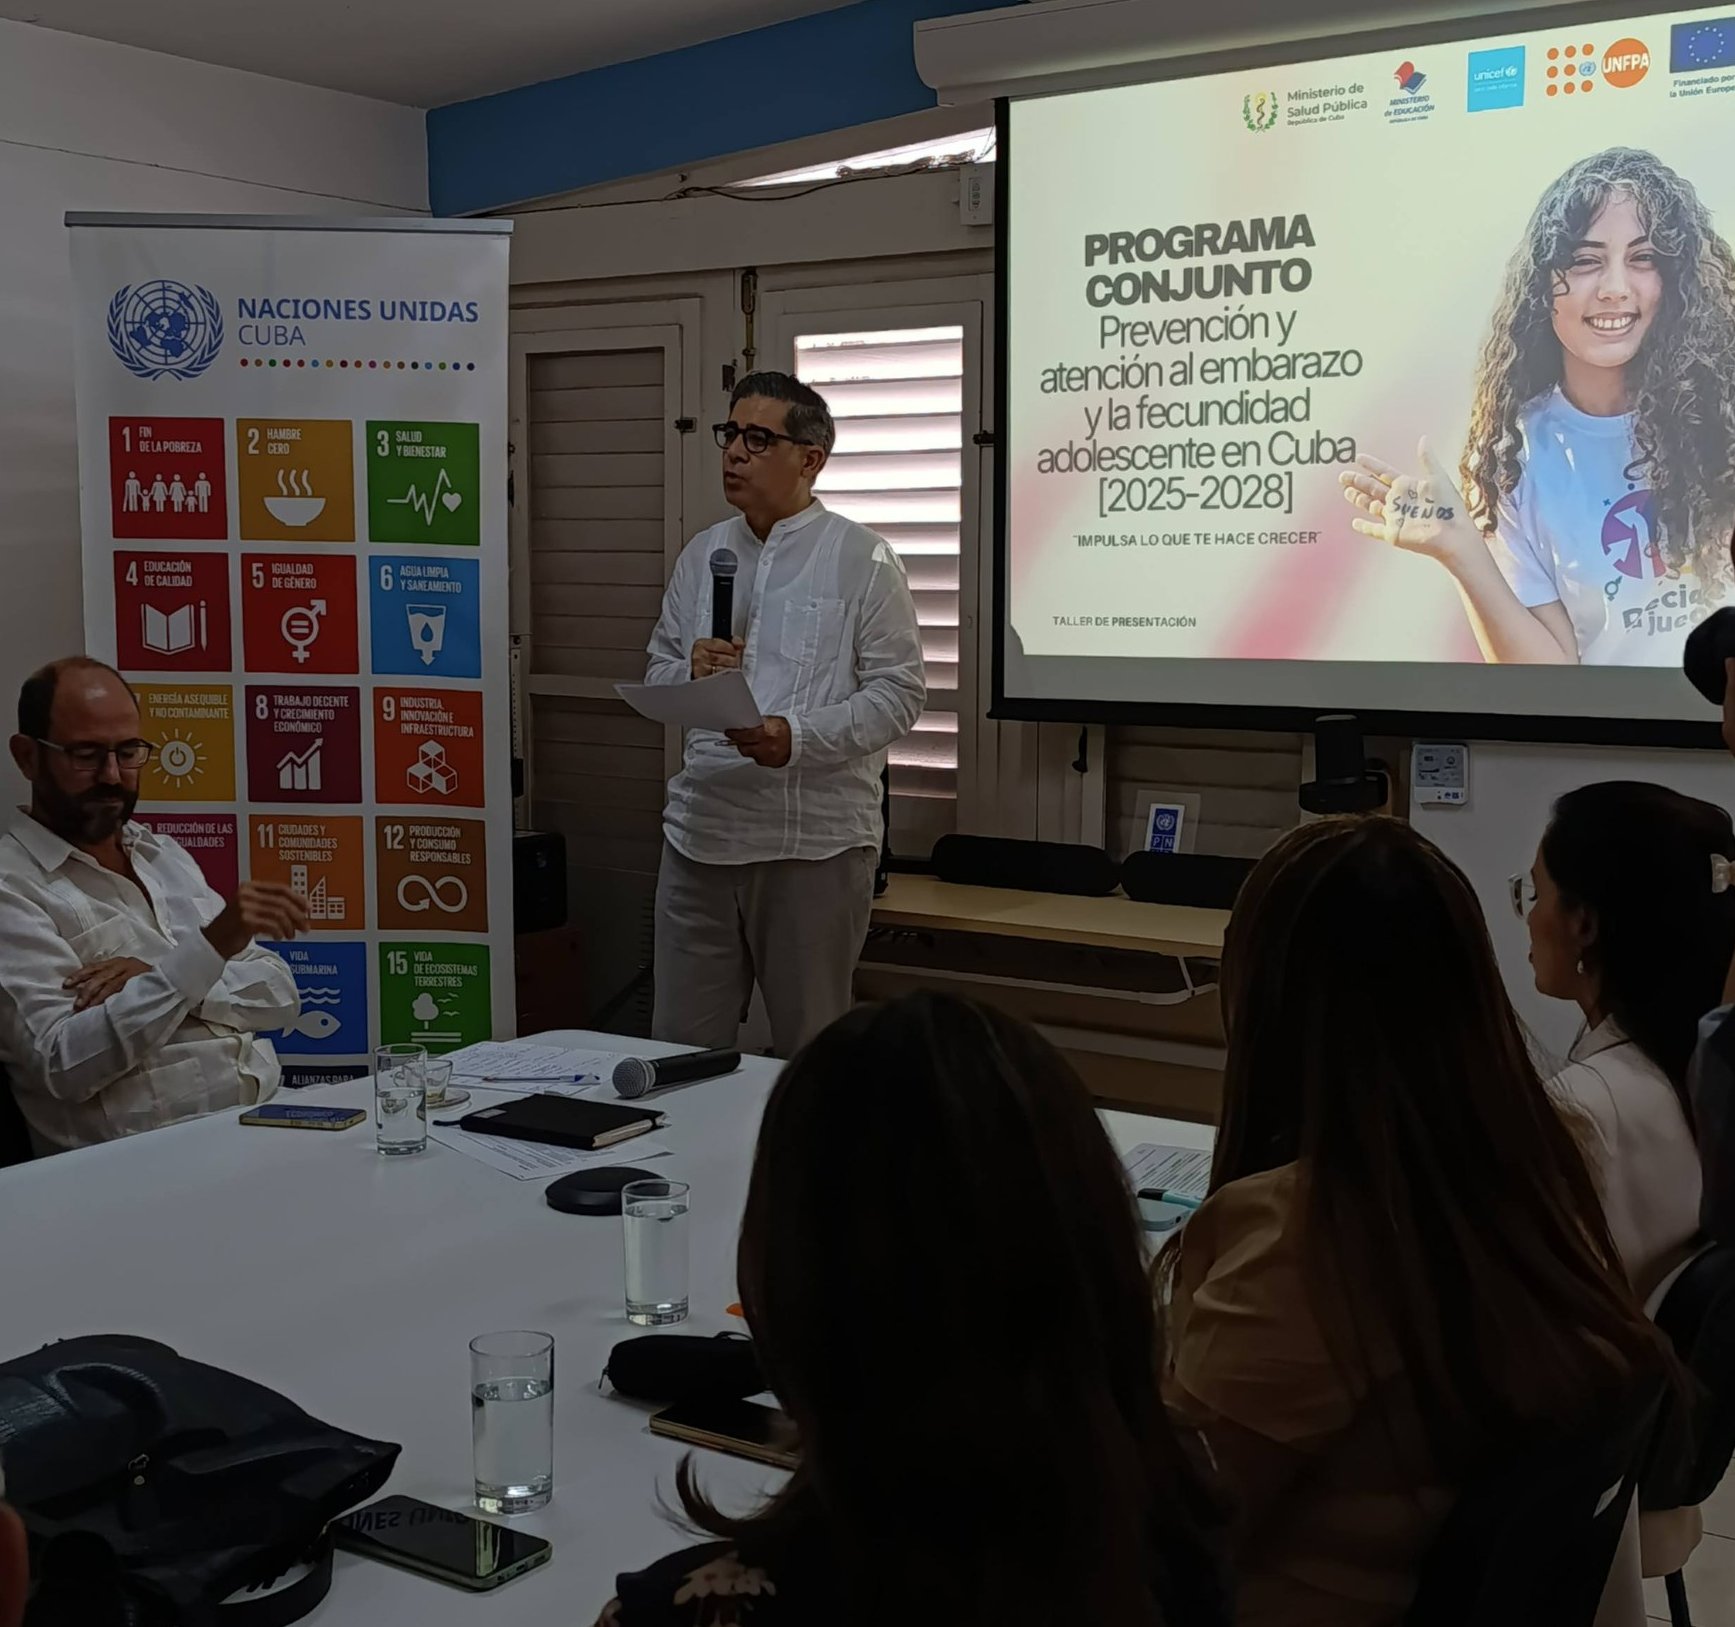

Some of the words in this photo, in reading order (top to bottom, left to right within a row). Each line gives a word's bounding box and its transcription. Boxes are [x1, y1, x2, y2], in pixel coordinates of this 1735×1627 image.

[1601, 53, 1649, 74] UNFPA
[1473, 66, 1504, 81] unicef
[1673, 76, 1719, 87] Financiado
[1287, 85, 1345, 102] Ministerio
[1348, 83, 1364, 94] de
[1679, 88, 1703, 97] Unión
[1389, 95, 1430, 106] MINISTERIO
[1287, 103, 1320, 118] Salud
[1323, 99, 1368, 114] Pública
[1393, 104, 1435, 116] EDUCACIÓN
[1085, 213, 1316, 267] PROGRAMA
[1086, 257, 1312, 308] CONJUNTO
[238, 298, 371, 320] NACIONES
[380, 301, 479, 322] UNIDAS
[1100, 304, 1269, 349] Prevención
[1275, 309, 1297, 347] y
[238, 324, 306, 346] CUBA
[1040, 354, 1163, 393] atención
[1169, 351, 1193, 386] al
[1200, 348, 1363, 384] embarazo
[1084, 405, 1103, 440] y
[1108, 398, 1130, 431] la
[1136, 387, 1310, 430] fecundidad
[139, 427, 152, 437] FIN
[267, 428, 301, 440] HAMBRE
[395, 431, 422, 442] SALUD
[122, 426, 131, 452] 1
[247, 428, 259, 454] 2
[377, 430, 389, 456] 3
[139, 441, 150, 452] DE
[151, 441, 162, 452] LA
[163, 441, 202, 453] POBREZA
[267, 444, 290, 454] CERO
[396, 445, 402, 456] Y
[403, 445, 446, 458] BIENESTAR
[1037, 437, 1216, 473] adolescente
[1221, 441, 1261, 467] en
[1268, 430, 1356, 466] Cuba
[1393, 496, 1454, 520] SUEÑOS
[1141, 535, 1159, 546] LO
[1162, 533, 1190, 546] QUE
[1193, 533, 1211, 545] TE
[1214, 532, 1255, 545] HACE
[144, 560, 192, 572] EDUCACIÓN
[272, 563, 313, 575] IGUALDAD
[400, 565, 422, 577] AGUA
[423, 566, 449, 578] LIMPIA
[125, 561, 138, 586] 4
[252, 563, 264, 588] 5
[380, 565, 393, 590] 6
[144, 575, 155, 586] DE
[156, 575, 192, 587] CALIDAD
[272, 577, 283, 588] DE
[284, 576, 316, 589] GÉNERO
[400, 579, 406, 590] Y
[406, 579, 461, 593] SANEAMIENTO
[1052, 616, 1093, 627] TALLER
[1095, 616, 1109, 627] DE
[1111, 615, 1196, 628] PRESENTACIÓN
[149, 692, 182, 705] ENERGÍA
[184, 693, 228, 706] ASEQUIBLE
[273, 695, 312, 706] TRABAJO
[313, 696, 349, 707] DECENTE
[255, 694, 268, 719] 8
[382, 696, 395, 721] 9
[149, 708, 155, 718] Y
[155, 708, 166, 718] NO
[167, 708, 229, 719] CONTAMINANTE
[273, 709, 279, 719] Y
[280, 709, 334, 720] CRECIMIENTO
[401, 709, 448, 722] INNOVACIÓN
[449, 712, 454, 722] E
[274, 720, 322, 733] ECONÓMICO
[401, 722, 474, 738] INFRAESTRUCTURA
[157, 821, 204, 833] REDUCCIÓN
[205, 823, 215, 833] DE
[217, 823, 233, 834] LAS
[278, 824, 319, 836] CIUDADES
[320, 825, 326, 836] Y
[409, 825, 461, 838] PRODUCCIÓN
[256, 824, 274, 848] 11
[383, 825, 404, 849] 12
[278, 837, 337, 849] COMUNIDADES
[410, 839, 415, 849] Y
[416, 839, 456, 850] CONSUMO
[279, 850, 332, 862] SOSTENIBLES
[410, 851, 471, 865] RESPONSABLES
[290, 951, 309, 961] VIDA
[413, 951, 433, 961] VIDA
[387, 951, 408, 975] 15
[413, 963, 425, 974] DE
[425, 964, 478, 976] ECOSISTEMAS
[414, 976, 462, 987] TERRESTRES
